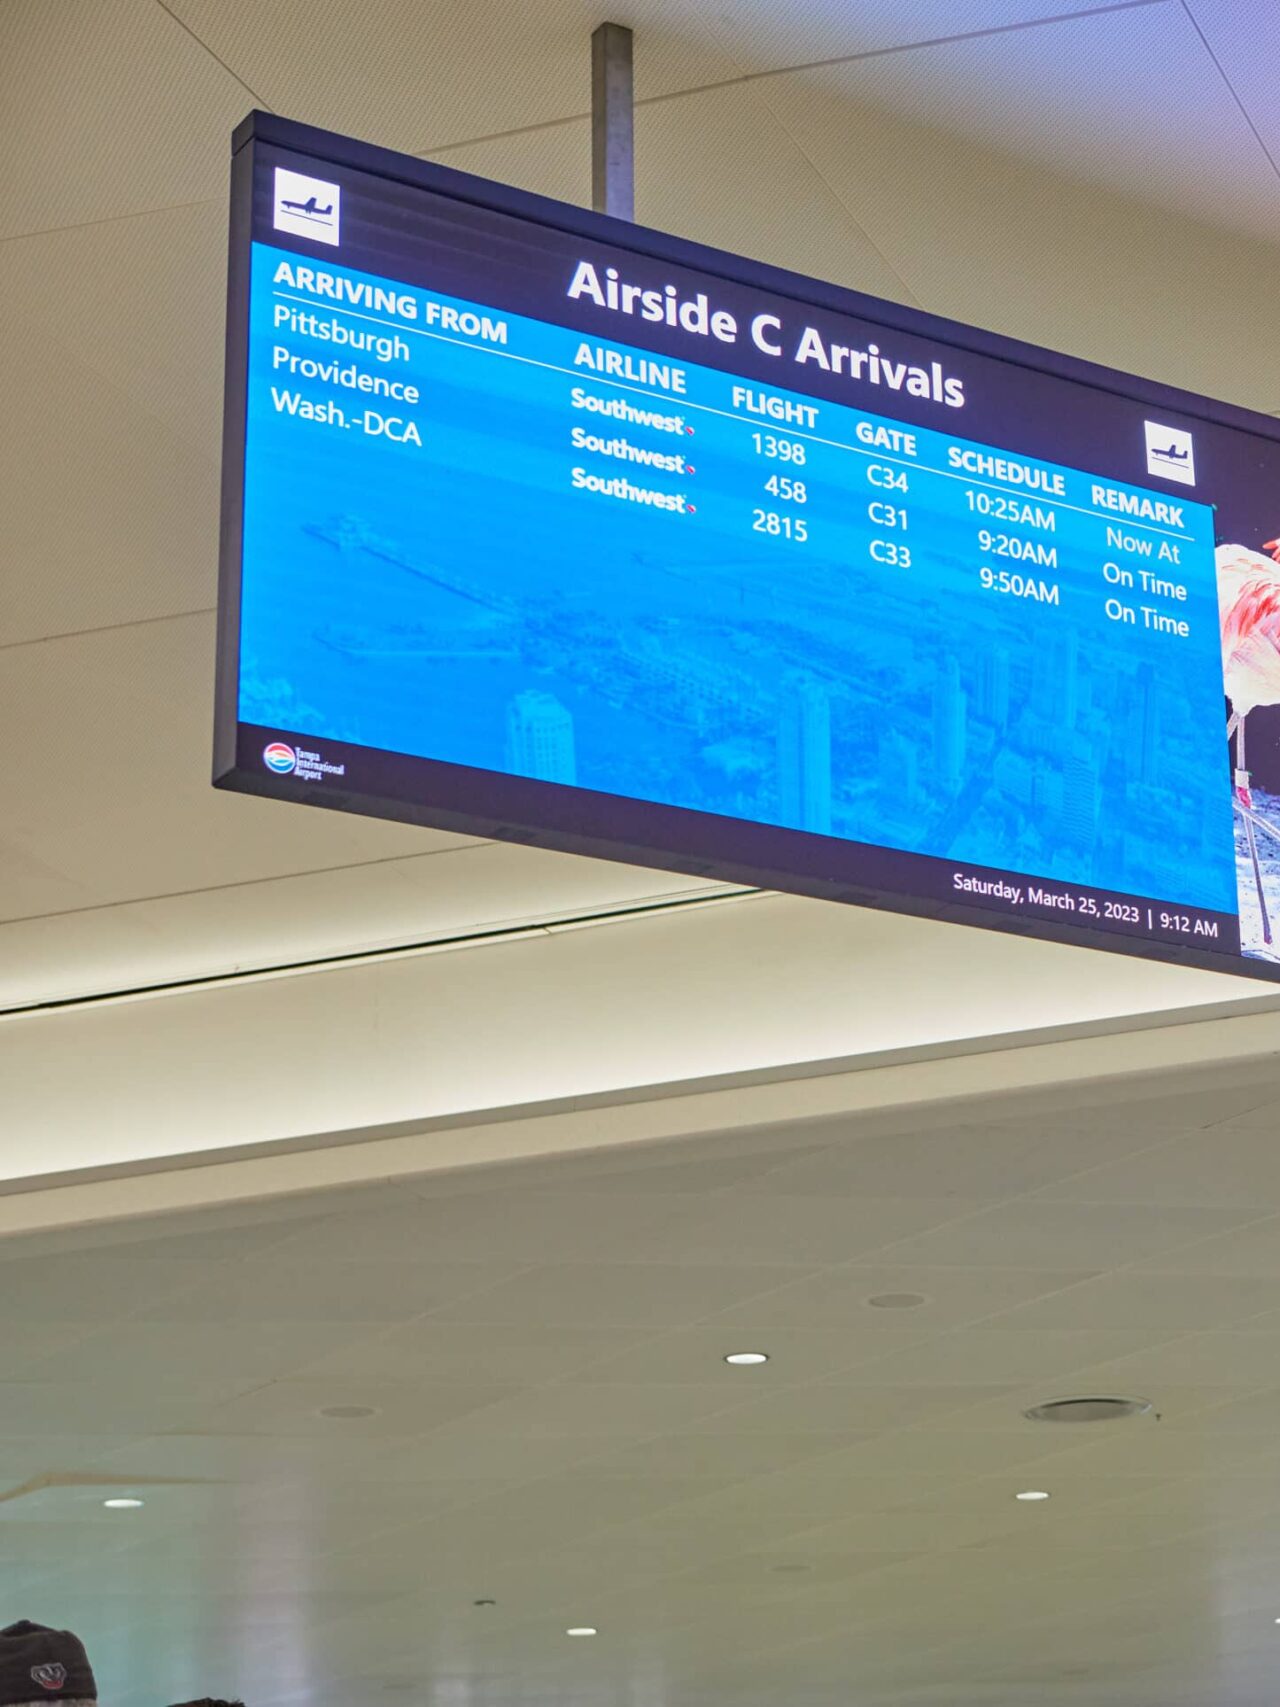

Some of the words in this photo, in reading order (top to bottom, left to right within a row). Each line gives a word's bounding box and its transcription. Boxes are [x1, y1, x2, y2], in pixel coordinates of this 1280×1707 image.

[273, 261, 417, 319] ARRIVING
[426, 303, 507, 344] FROM
[274, 306, 409, 362] Pittsburgh
[567, 261, 737, 343] Airside
[751, 313, 782, 356] C
[795, 327, 966, 408] Arrivals
[273, 346, 419, 403] Providence
[575, 343, 686, 394] AIRLINE
[271, 387, 422, 447] Wash.-DCA
[571, 387, 685, 435] Southwest
[732, 386, 819, 428] FLIGHT
[571, 427, 685, 474] Southwest
[751, 433, 806, 465] 1398
[856, 422, 917, 457] GATE
[571, 467, 685, 514] Southwest
[764, 474, 807, 504] 458
[867, 464, 909, 493] C34
[948, 446, 1065, 496] SCHEDULE
[752, 509, 808, 542] 2815
[868, 502, 908, 530] C31
[965, 490, 1056, 532] 10:25AM
[1092, 485, 1184, 528] REMARK
[869, 539, 911, 568] C33
[978, 530, 1058, 568] 9:20AM
[1106, 527, 1151, 559] Now
[1156, 540, 1181, 565] At
[980, 567, 1060, 606] 9:50AM
[1103, 563, 1132, 586] On
[1138, 571, 1188, 601] Time
[1105, 600, 1136, 624] On
[1141, 608, 1190, 638] Time
[295, 747, 320, 761] Tampa
[297, 757, 344, 775] International
[295, 767, 322, 781] Airport
[953, 873, 1024, 904] Saturday,
[1028, 887, 1075, 911] March
[1079, 897, 1101, 918] 25,
[1104, 902, 1140, 923] 2023
[1160, 913, 1190, 933] 9:12
[1193, 919, 1219, 938] AM
